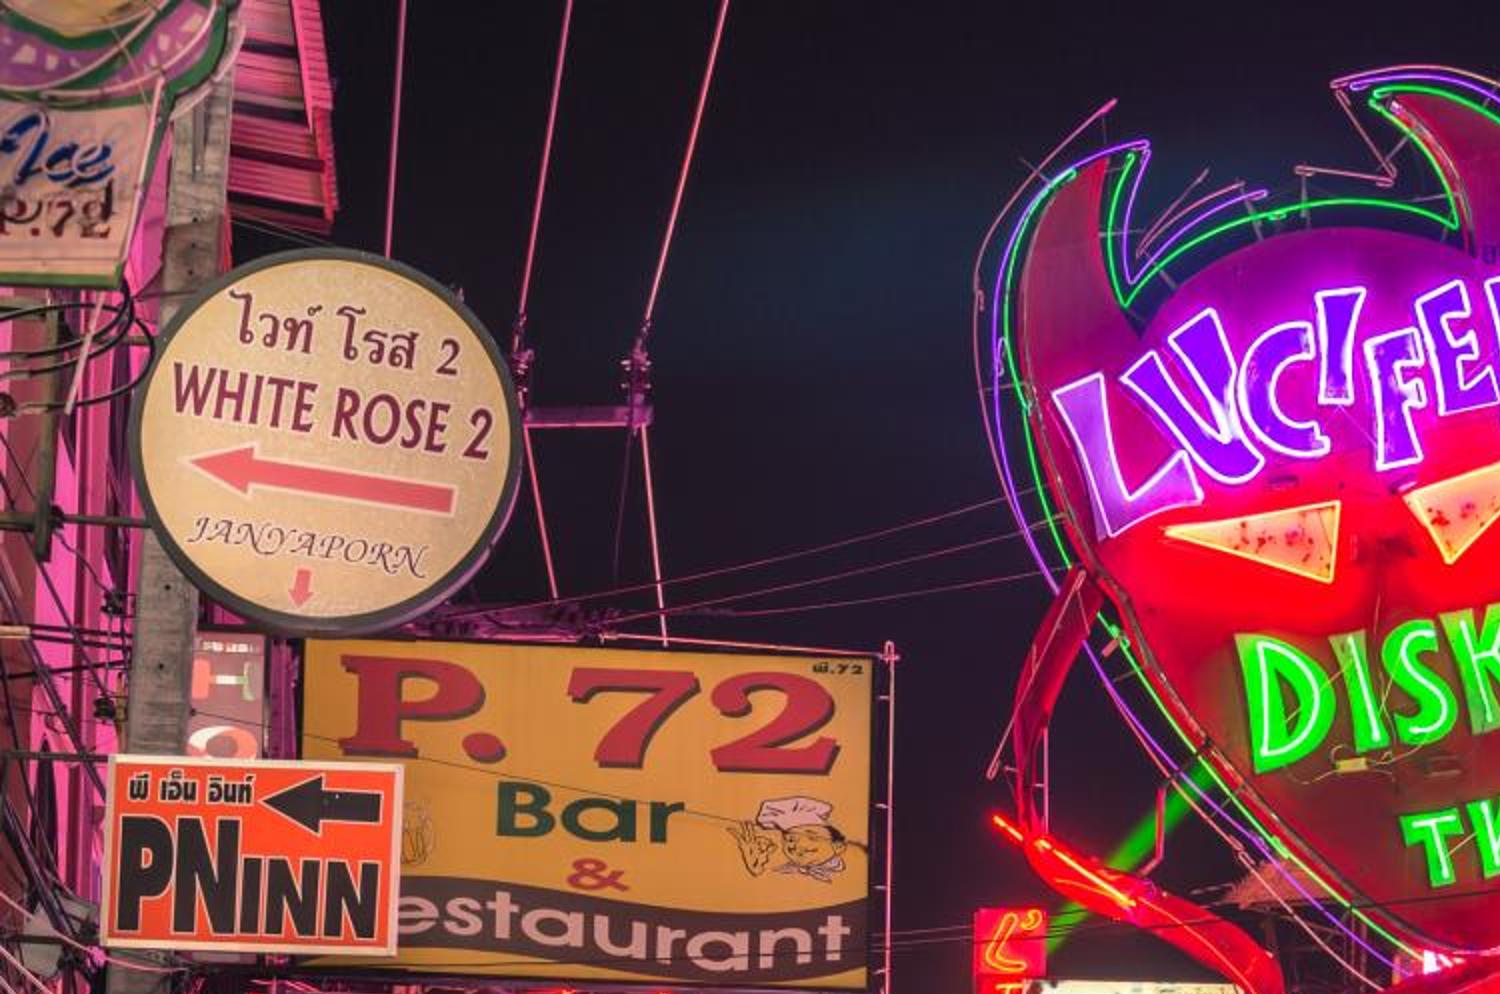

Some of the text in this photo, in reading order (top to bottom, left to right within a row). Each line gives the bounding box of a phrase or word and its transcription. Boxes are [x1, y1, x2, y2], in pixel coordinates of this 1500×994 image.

[229, 289, 460, 376] ไวท์ โรส 2
[173, 362, 494, 460] WHITE ROSE 2
[187, 516, 428, 578] JANYAPORN
[567, 667, 841, 776] 72
[496, 781, 686, 844] Bar
[566, 858, 629, 892] &
[397, 889, 851, 973] estaurant
